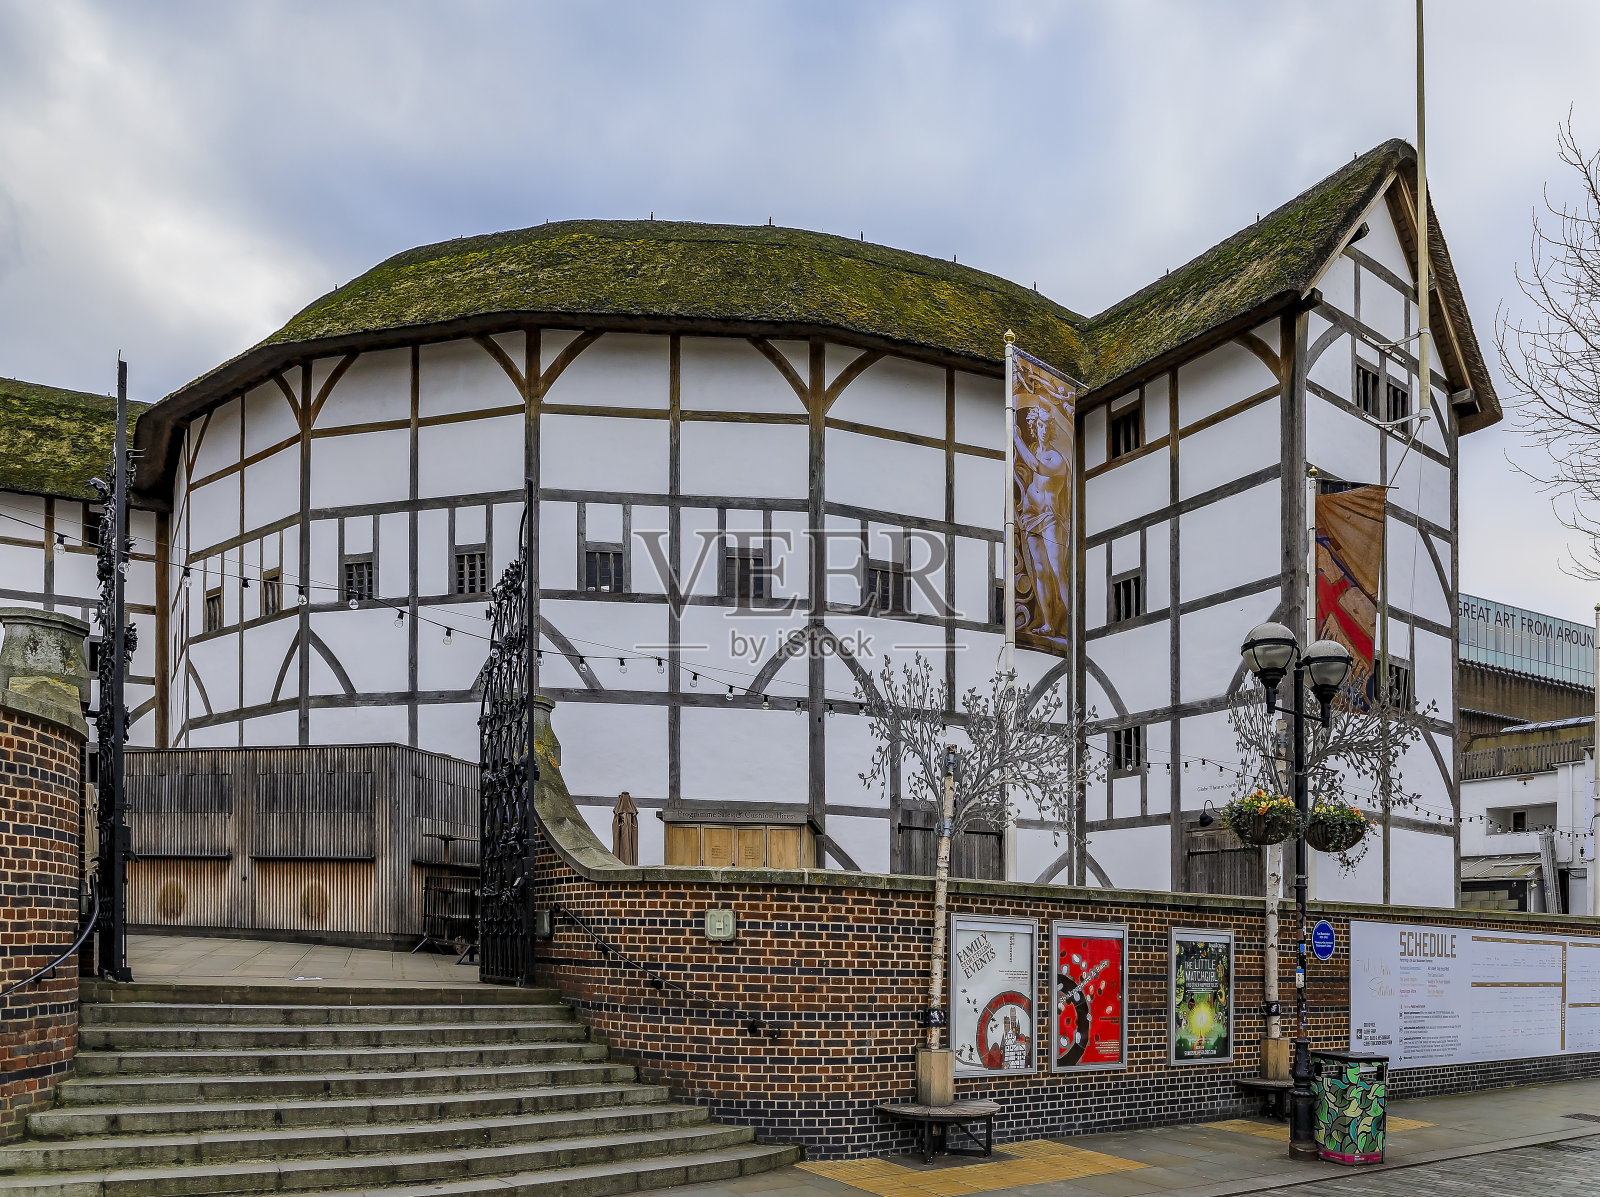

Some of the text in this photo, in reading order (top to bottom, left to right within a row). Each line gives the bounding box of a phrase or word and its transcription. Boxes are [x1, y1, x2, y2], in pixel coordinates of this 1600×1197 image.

[1494, 610, 1516, 629] ART
[1521, 617, 1553, 639] FROM
[677, 810, 716, 819] Programme
[956, 931, 988, 963] FAMILY
[960, 941, 992, 970] STORYTELLING
[1399, 931, 1457, 958] SCHEDULE
[963, 947, 996, 980] EVENTS
[1184, 958, 1216, 970] THE LITTLE
[1185, 970, 1218, 982] MATCHGIRL
